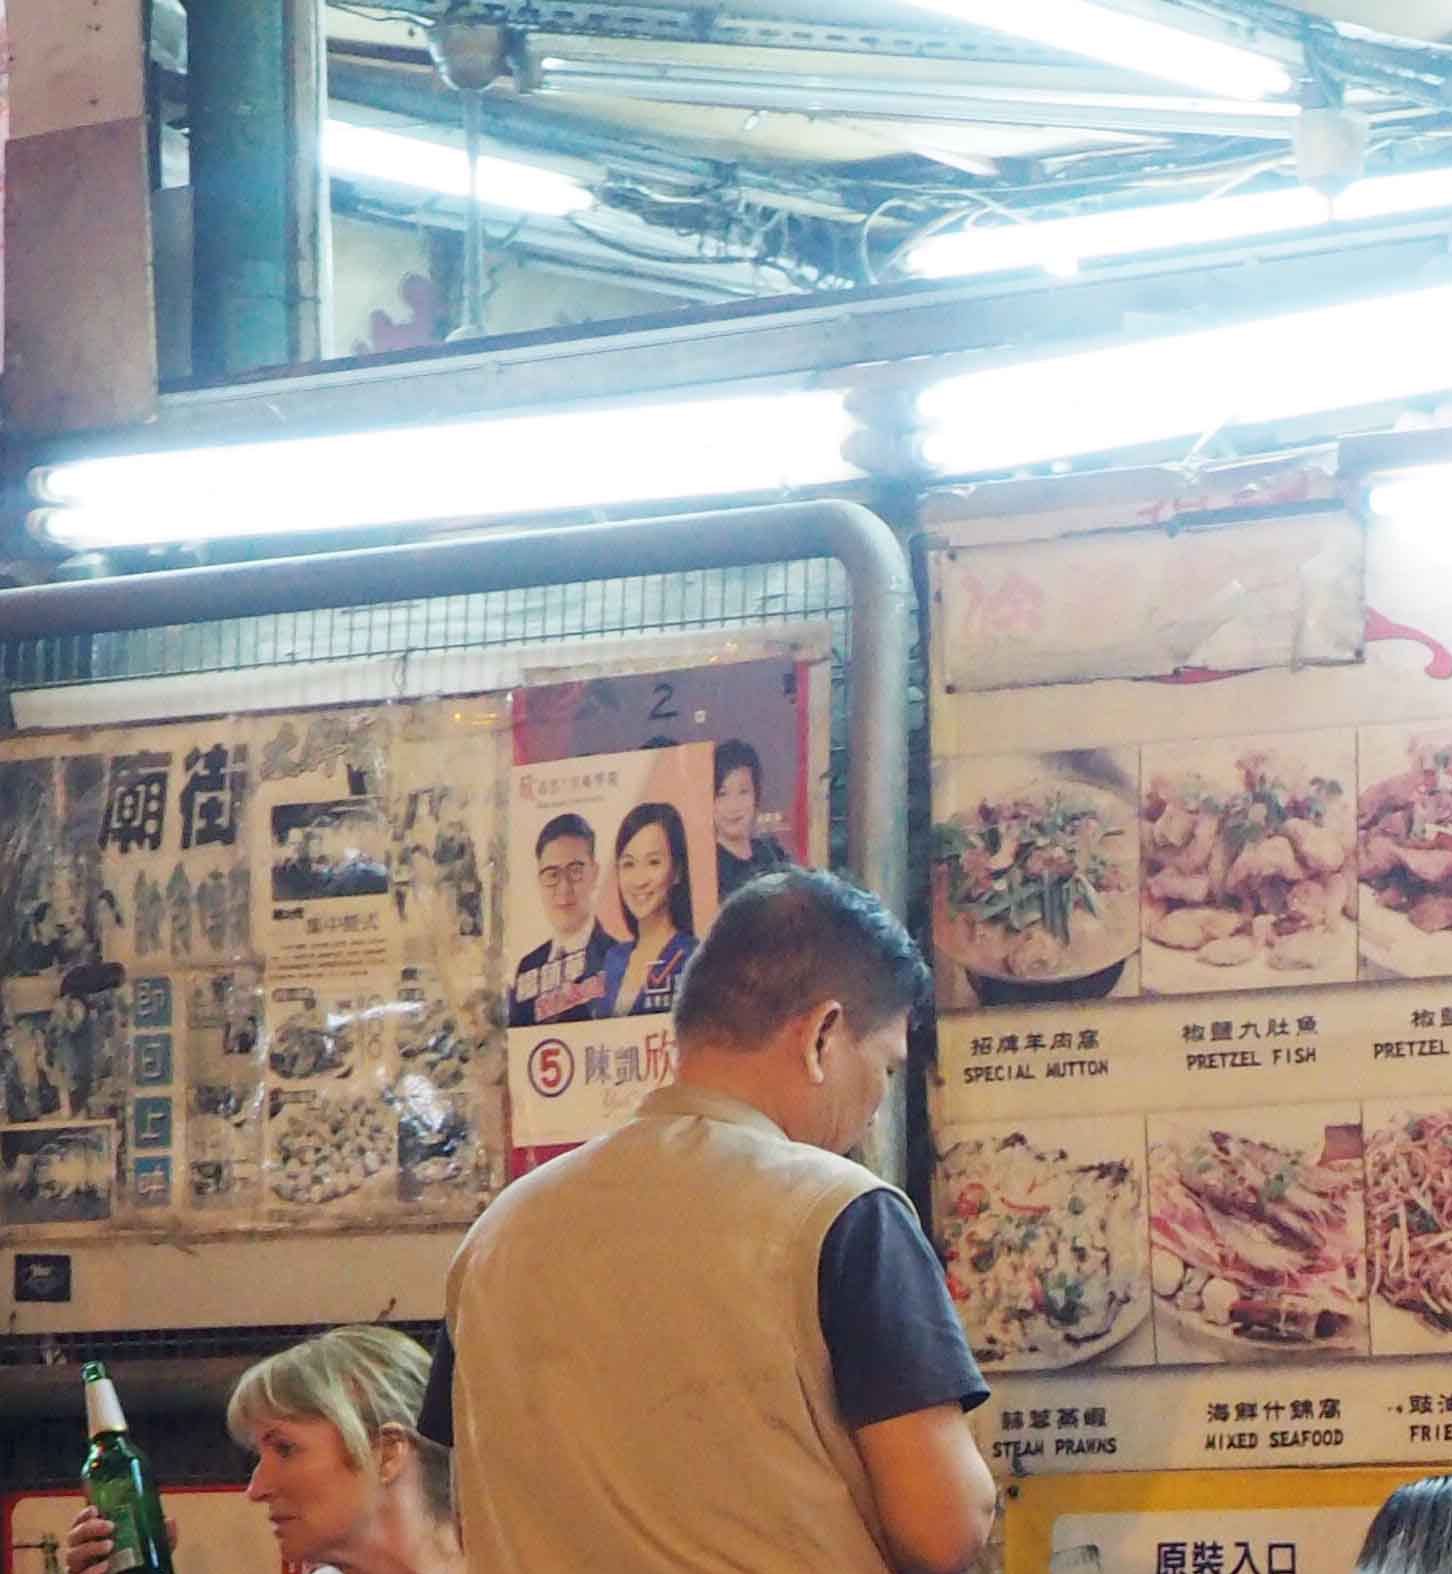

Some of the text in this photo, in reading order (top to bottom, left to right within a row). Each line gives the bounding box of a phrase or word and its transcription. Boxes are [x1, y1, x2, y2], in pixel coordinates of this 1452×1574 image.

[650, 683, 679, 720] 2
[1186, 1047, 1317, 1071] PRETZEL FISH
[1374, 1038, 1450, 1060] PRETZEL
[963, 1059, 1110, 1085] SPECIAL MUTTON
[1054, 1436, 1118, 1456] PRAWNS
[1204, 1428, 1345, 1451] MIXED SEAFOOD
